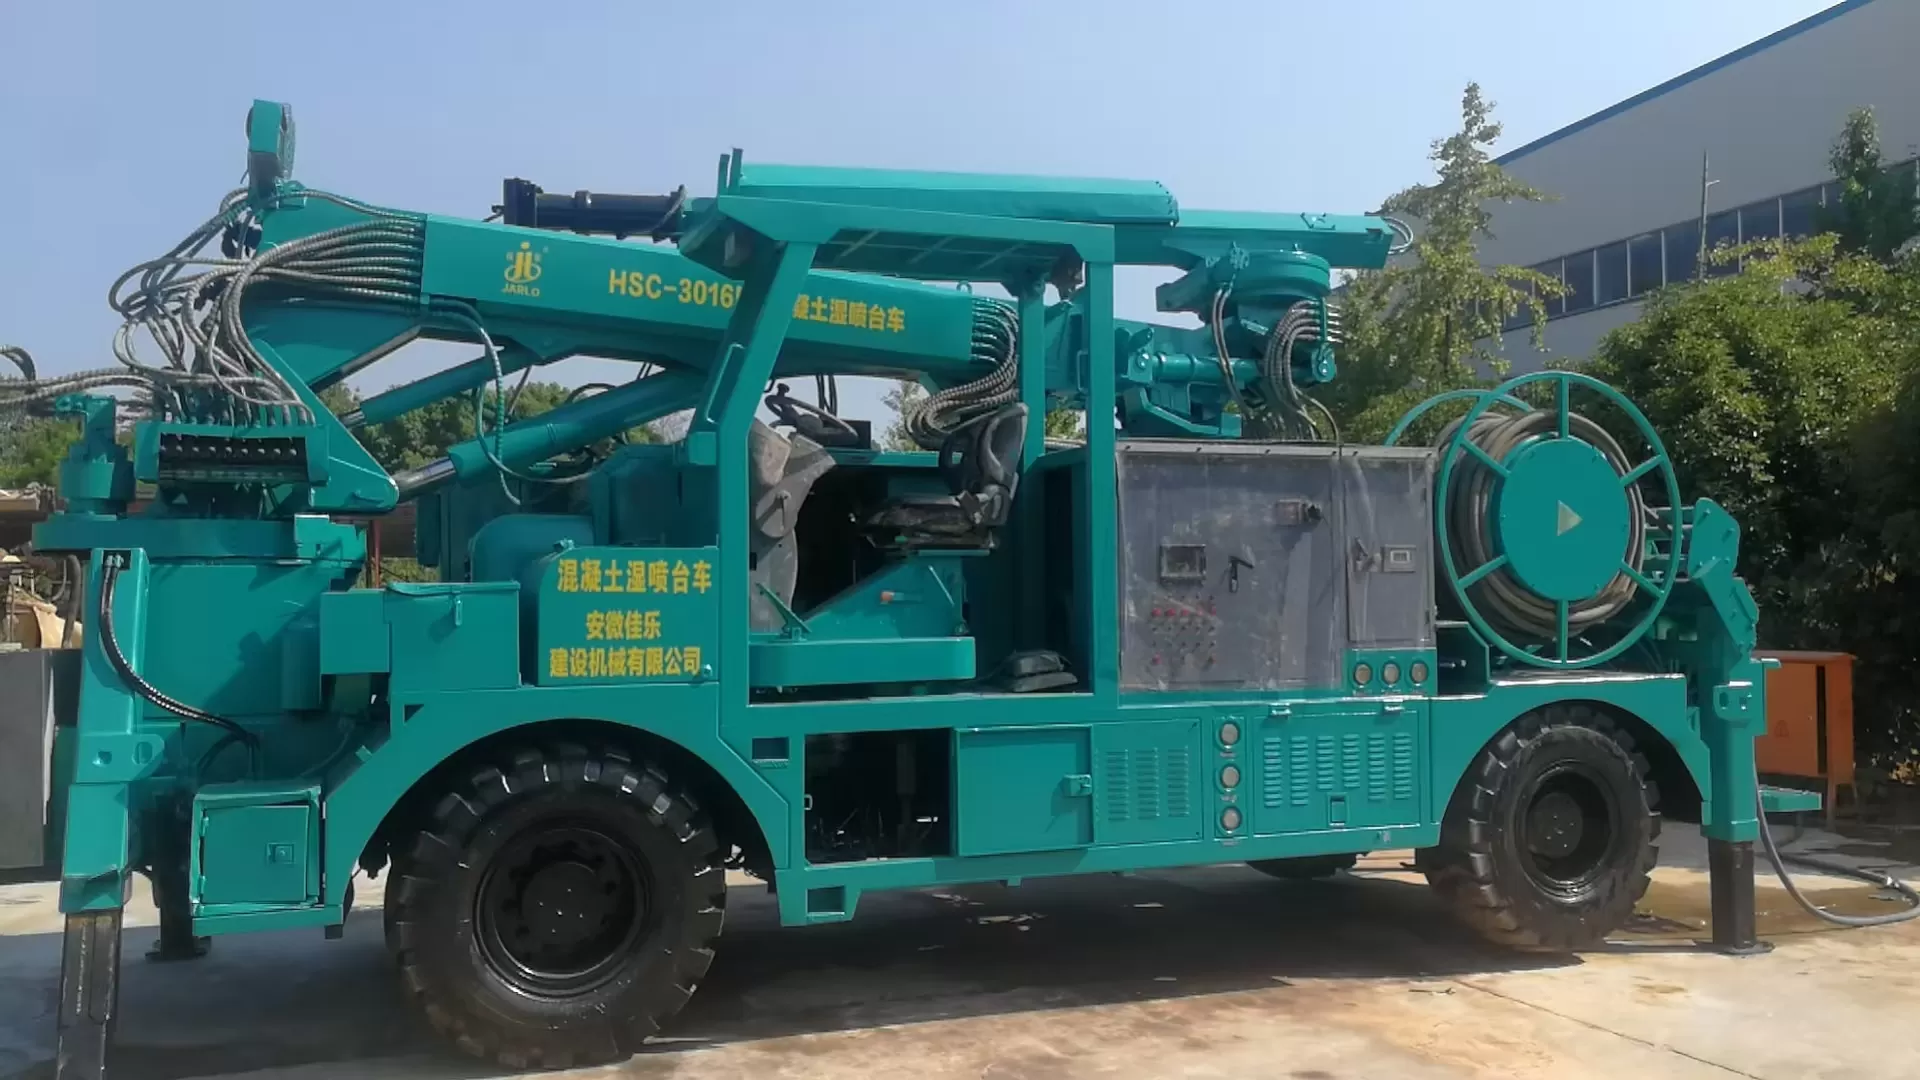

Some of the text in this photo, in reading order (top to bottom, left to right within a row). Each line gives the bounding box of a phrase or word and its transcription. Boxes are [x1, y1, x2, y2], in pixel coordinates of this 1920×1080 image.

[500, 283, 541, 297] JARLO
[557, 558, 712, 594] 混凝土湿喷台车
[586, 610, 661, 640] 安徽佳乐
[550, 646, 701, 678] 建设机械有限公司
